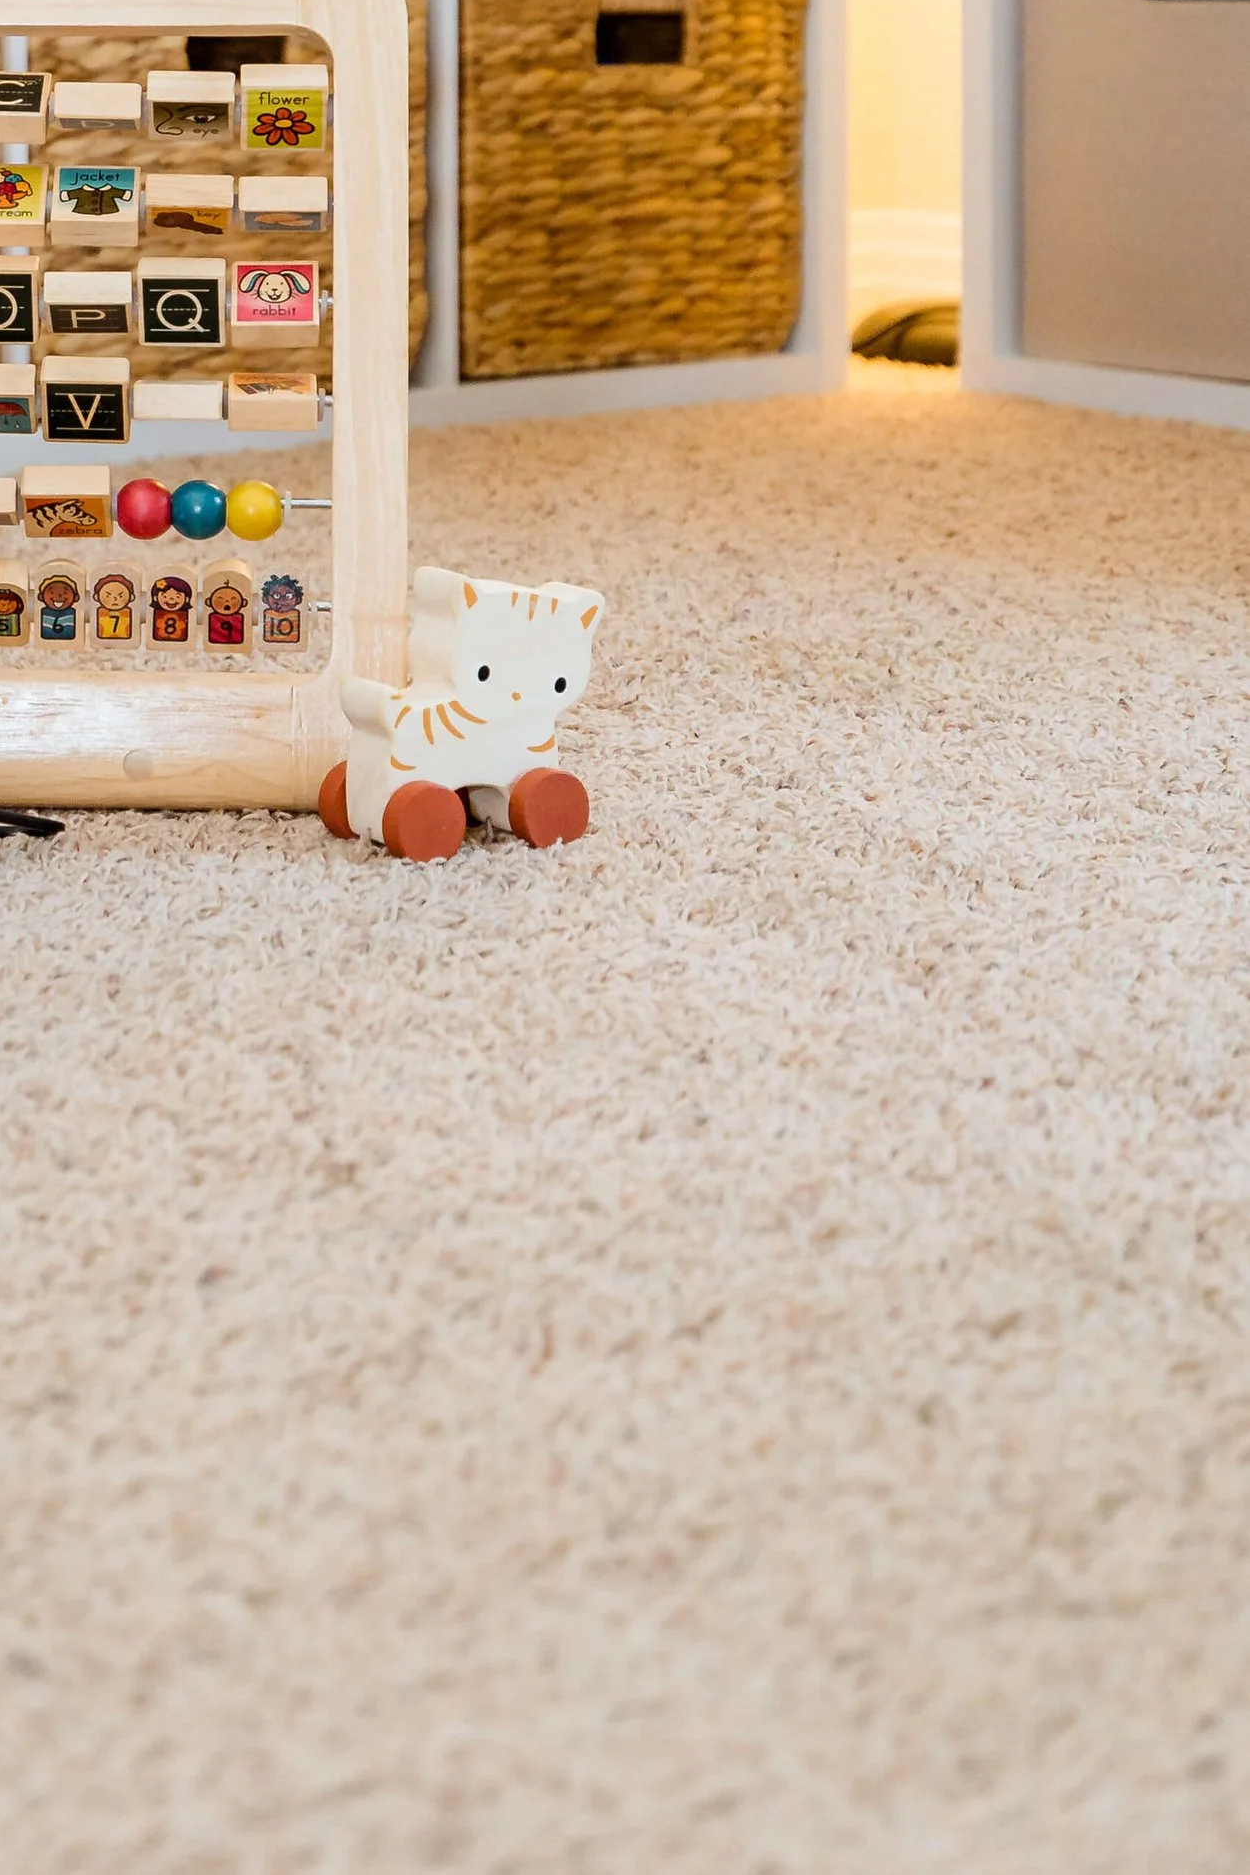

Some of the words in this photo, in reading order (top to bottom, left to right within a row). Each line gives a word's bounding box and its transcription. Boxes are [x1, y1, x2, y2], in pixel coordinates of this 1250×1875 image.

[258, 91, 310, 106] flower
[193, 128, 220, 138] eye
[70, 171, 121, 185] jacket
[197, 209, 221, 220] key
[71, 309, 106, 328] P
[156, 289, 205, 333] Q
[252, 305, 296, 317] rabbit
[67, 393, 101, 430] V
[59, 526, 103, 535] zebra
[52, 615, 65, 634] 6
[110, 615, 120, 633] 7
[164, 617, 177, 635] 8
[220, 620, 232, 637] 9
[268, 616, 295, 637] 10
